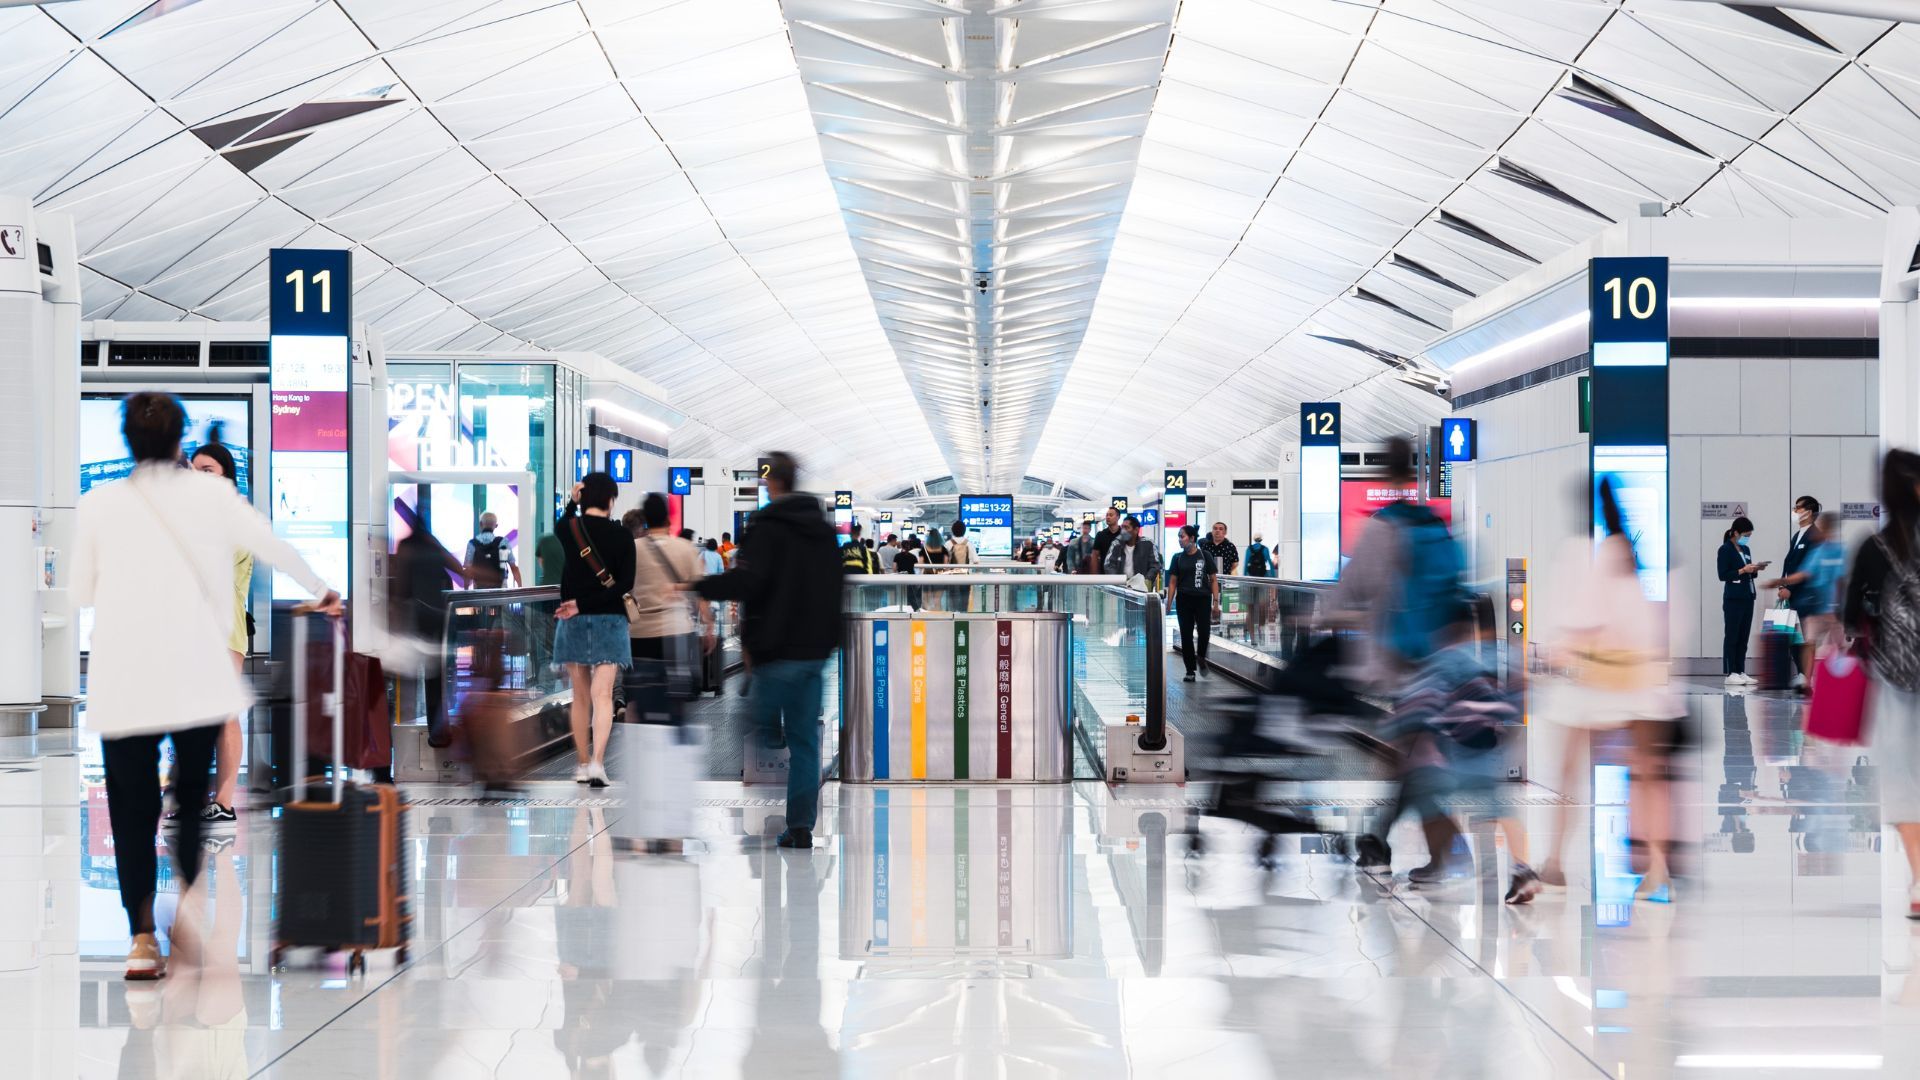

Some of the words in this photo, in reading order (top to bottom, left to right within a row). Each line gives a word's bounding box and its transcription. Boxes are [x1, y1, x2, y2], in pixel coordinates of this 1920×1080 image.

[286, 269, 331, 313] 11
[1604, 277, 1656, 319] 10
[273, 394, 288, 402] Hong
[289, 394, 303, 402] Kong
[273, 405, 300, 415] Sydney
[1306, 413, 1334, 435] 12
[762, 464, 771, 478] 2
[1166, 475, 1184, 489] 24
[837, 495, 851, 506] 25
[990, 504, 1010, 512] 13-22
[1113, 500, 1126, 510] 26
[999, 654, 1009, 694] 一般廢物
[876, 680, 886, 708] Paper
[914, 680, 923, 703] Cans
[957, 680, 966, 718] Plastics
[1000, 696, 1009, 732] General
